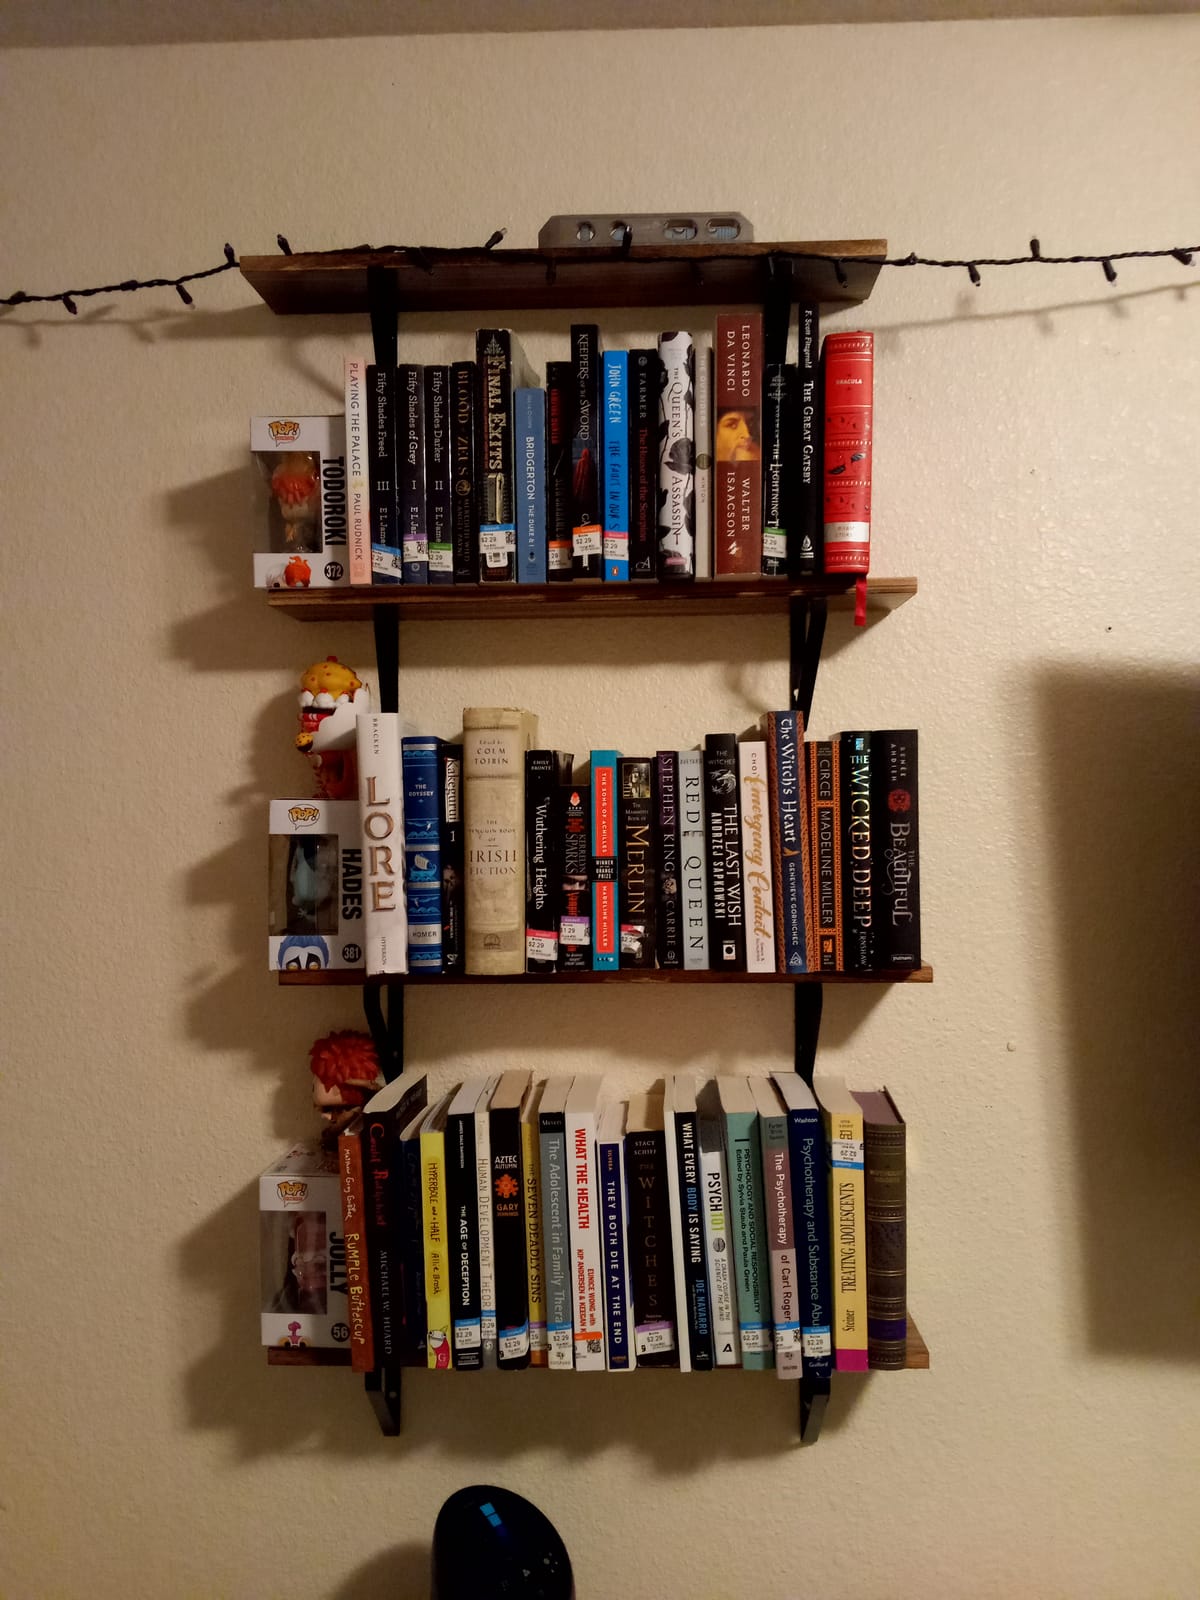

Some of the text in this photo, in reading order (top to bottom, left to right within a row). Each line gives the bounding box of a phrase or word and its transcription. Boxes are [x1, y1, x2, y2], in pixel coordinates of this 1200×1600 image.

[577, 333, 590, 441] KEEPERS SWORD
[608, 364, 621, 423] JOHN GREEN
[727, 331, 735, 392] DA VINCI
[741, 325, 750, 397] LEONARDO
[269, 421, 299, 436] POP!
[350, 363, 361, 476] PLAYING THE PALACE
[377, 372, 387, 457] Fifty Shades Freed
[407, 371, 418, 465] Fifty Shades of Grey
[432, 371, 443, 463] Fifty Shades Darker
[458, 371, 469, 475] BLOOD ZEUS
[488, 355, 506, 470] FINAL EXITS
[667, 382, 683, 438] QUEEN'S
[802, 381, 814, 484] THE GREAT GATSBY
[526, 436, 535, 499] BRIDGERTON
[609, 440, 619, 458] THE
[323, 456, 345, 545] TODOROKI
[672, 476, 683, 539] ASSASSIN
[727, 472, 735, 537] ISAACSON
[741, 478, 749, 531] WALTER
[770, 463, 782, 517] LIGHTNING
[353, 493, 363, 560] PAUL RUDNICK
[326, 564, 341, 579] 372
[476, 748, 504, 757] COLM
[819, 759, 831, 797] CIRCE
[289, 808, 319, 821] POP!
[446, 759, 458, 821] Kakegurui
[662, 758, 675, 872] STEPHEN KING
[686, 777, 701, 824] RED
[781, 744, 797, 842] Witch's Heart
[365, 776, 396, 912] LORE
[534, 804, 547, 909] Wuthering Heights
[564, 833, 577, 874] SPARKS
[625, 824, 649, 913] MERLIN
[711, 812, 725, 919] ANDRZEJ SAPKOWSKI
[724, 803, 741, 926] THE LAST WISH
[744, 775, 771, 939] Emergency Contact
[820, 811, 832, 924] MADELINE MILLER
[848, 766, 872, 928] WICKED DEEP
[342, 849, 361, 919] HADES
[685, 856, 703, 951] QUEEN
[344, 948, 359, 958] 381
[412, 931, 437, 941] HOMER
[666, 900, 675, 946] CARRIE
[791, 904, 799, 946] GORNICHEC
[495, 1156, 518, 1164] AZTEC
[549, 1138, 560, 1160] The
[575, 1129, 589, 1229] WHAT THE HEALTH
[744, 1149, 752, 1200] PSYCHOLOGY
[775, 1152, 785, 1170] The
[428, 1163, 440, 1242] HYPERBOLE HALF
[478, 1159, 491, 1267] HUMAN DEVELOPMENT
[550, 1163, 563, 1229] Adolescent
[682, 1123, 701, 1263] WHAT EVERY BODY SAYING
[708, 1173, 725, 1231] PSYCH101
[775, 1174, 787, 1244] Psychotherapy
[460, 1219, 470, 1306] AGE DECEPTION
[527, 1179, 540, 1303] SEVEN DEADLY SINS
[551, 1247, 564, 1285] Family
[607, 1181, 622, 1344] THEY BOTH DIE AT THE END
[801, 1138, 821, 1326] Psychotherapy and Substance Abu
[840, 1183, 856, 1293] TREATING ADOLESCENTS
[697, 1297, 707, 1335] NAVARRO
[781, 1255, 792, 1320] of Carl Roger
[333, 1328, 348, 1339] 56
